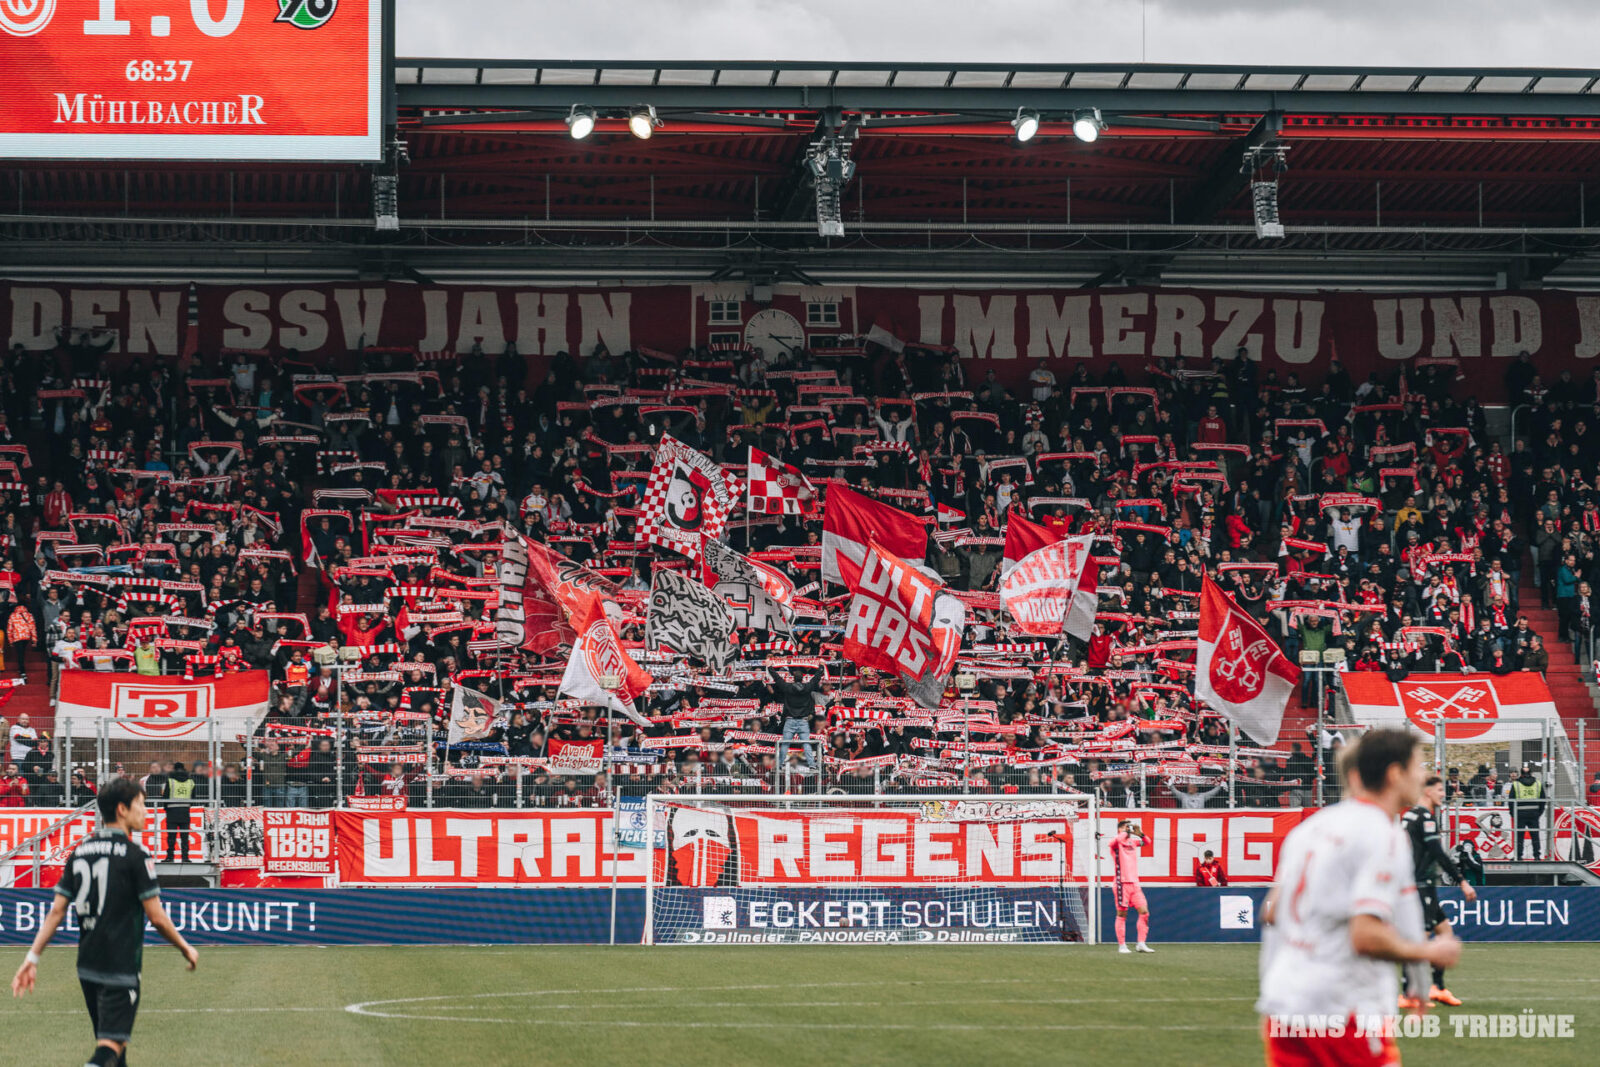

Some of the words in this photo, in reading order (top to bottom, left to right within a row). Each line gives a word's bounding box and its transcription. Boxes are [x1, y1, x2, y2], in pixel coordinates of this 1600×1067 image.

[125, 60, 193, 82] 68:37
[53, 93, 267, 125] MÜHLBACHER
[8, 286, 182, 355] DEN
[222, 288, 386, 352] SSV
[418, 290, 632, 357] JAHN
[917, 293, 1326, 364] IMMERZU
[1372, 295, 1543, 360] UND
[157, 523, 216, 533] REGENSBURG
[559, 744, 595, 759] Avanti
[267, 812, 292, 825] SSV
[295, 812, 330, 826] JAHN
[267, 827, 330, 859] 1889
[362, 817, 650, 878] ULTRAS
[267, 860, 330, 872] REGENSBURG
[72, 857, 109, 916] 21
[749, 900, 891, 928] ECKERT
[901, 900, 1057, 928] SCHULEN
[1438, 900, 1569, 926] CHULEN
[703, 931, 786, 943] Dallmeier
[799, 931, 899, 943] PANOMERA
[936, 931, 1018, 943] Dallmeier
